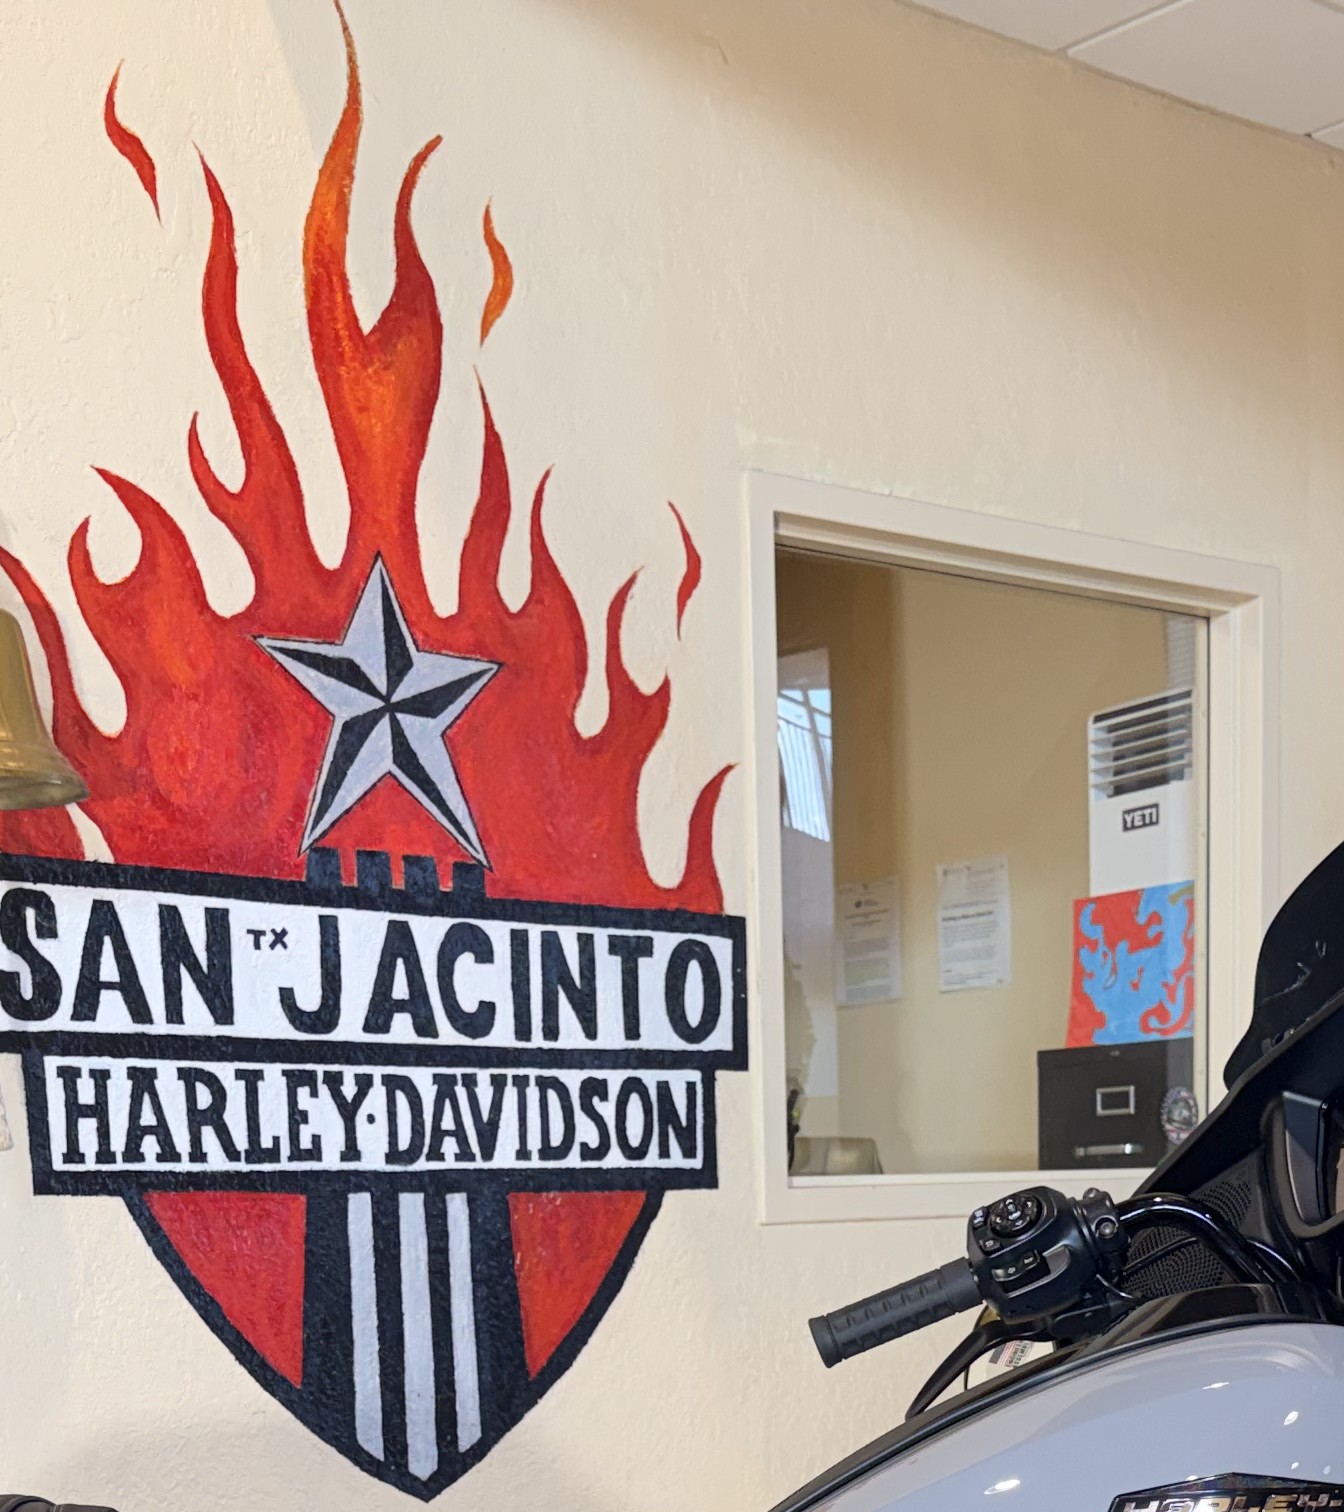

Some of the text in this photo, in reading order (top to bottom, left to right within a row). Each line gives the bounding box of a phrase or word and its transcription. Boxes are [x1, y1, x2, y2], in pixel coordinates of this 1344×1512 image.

[1123, 807, 1158, 829] YETI
[247, 927, 289, 953] TX
[279, 914, 723, 1045] JACINTO
